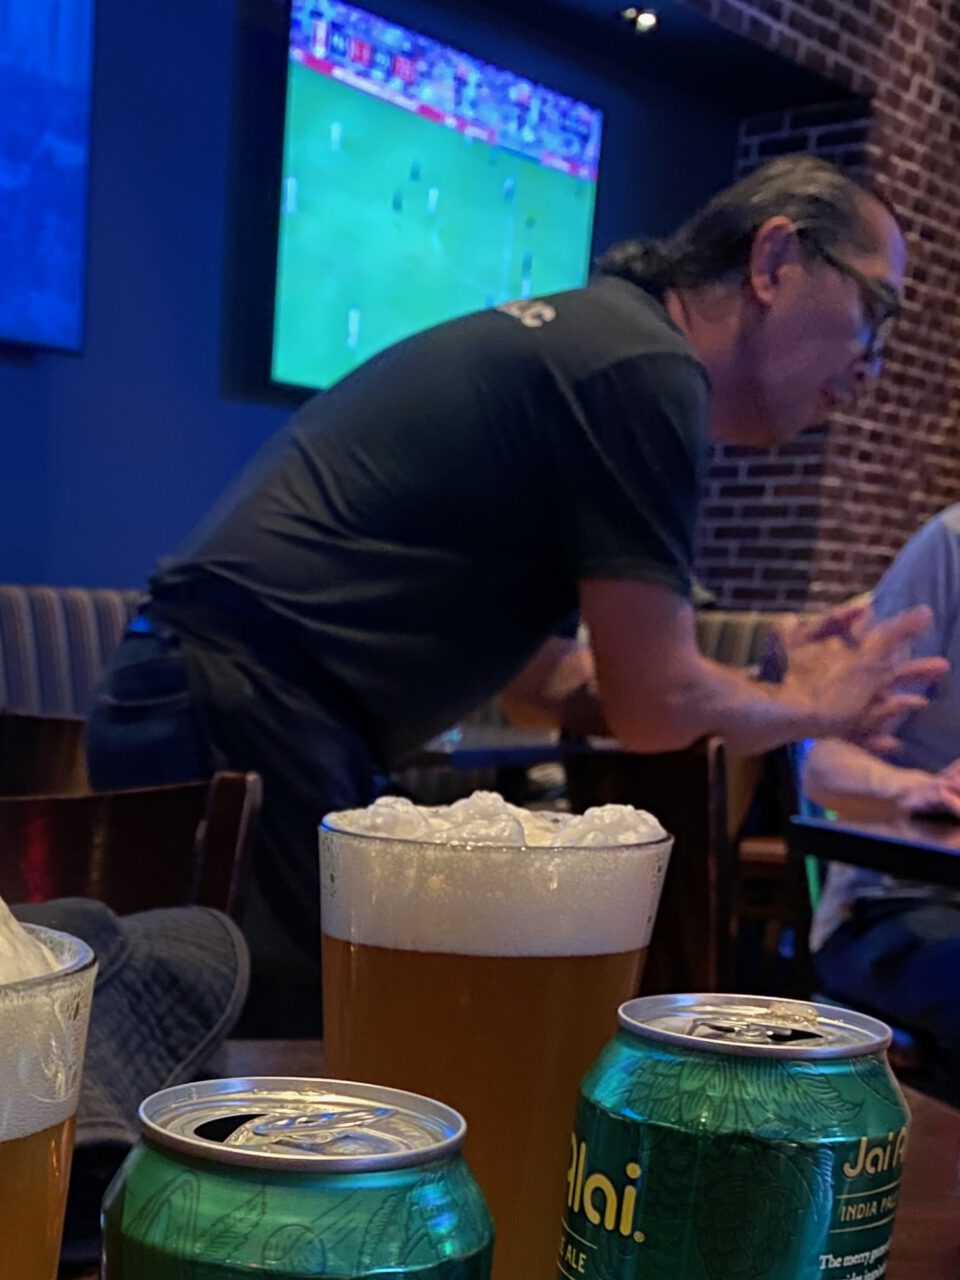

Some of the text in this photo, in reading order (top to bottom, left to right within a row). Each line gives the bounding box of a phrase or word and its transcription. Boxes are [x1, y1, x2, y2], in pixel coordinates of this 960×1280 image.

[842, 1131, 895, 1178] Jai
[841, 1201, 878, 1222] INDIA
[565, 1245, 587, 1274] ALE
[819, 1254, 842, 1270] The
